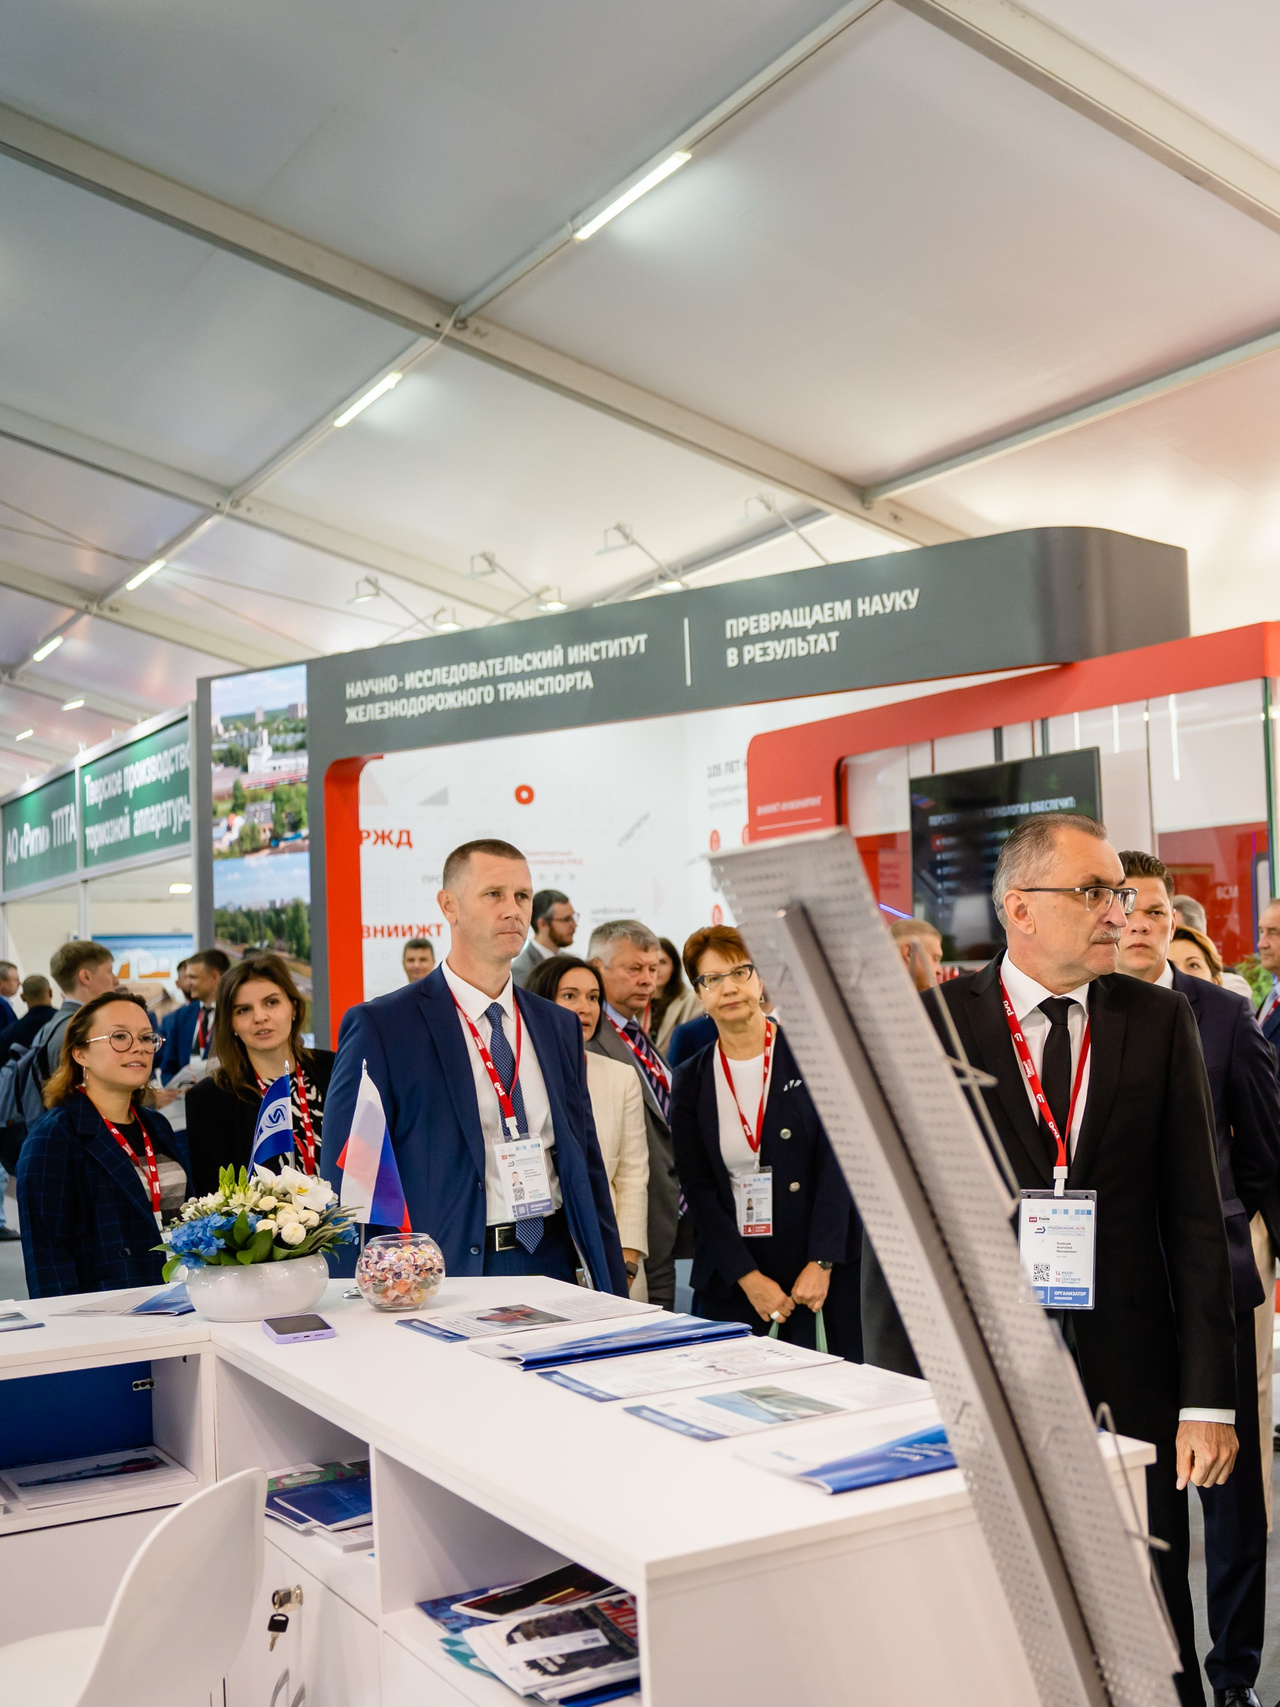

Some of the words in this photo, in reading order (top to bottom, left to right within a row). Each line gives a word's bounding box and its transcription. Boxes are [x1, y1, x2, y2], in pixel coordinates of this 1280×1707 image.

[725, 599, 852, 640] ПРЕВРАЩАЕМ
[858, 588, 920, 619] НАУКУ
[568, 634, 648, 665] ИНСТИТУТ
[726, 647, 739, 668] В
[743, 631, 840, 665] РЕЗУЛЬТАТ
[346, 685, 495, 724] ЖЕЛЕЗНОДОРОЖНОГО
[498, 671, 594, 701] ТРАНСПОРТА
[85, 805, 131, 856] тормозной
[359, 829, 413, 848] РЖД
[361, 923, 443, 939] ВНИИЖТ
